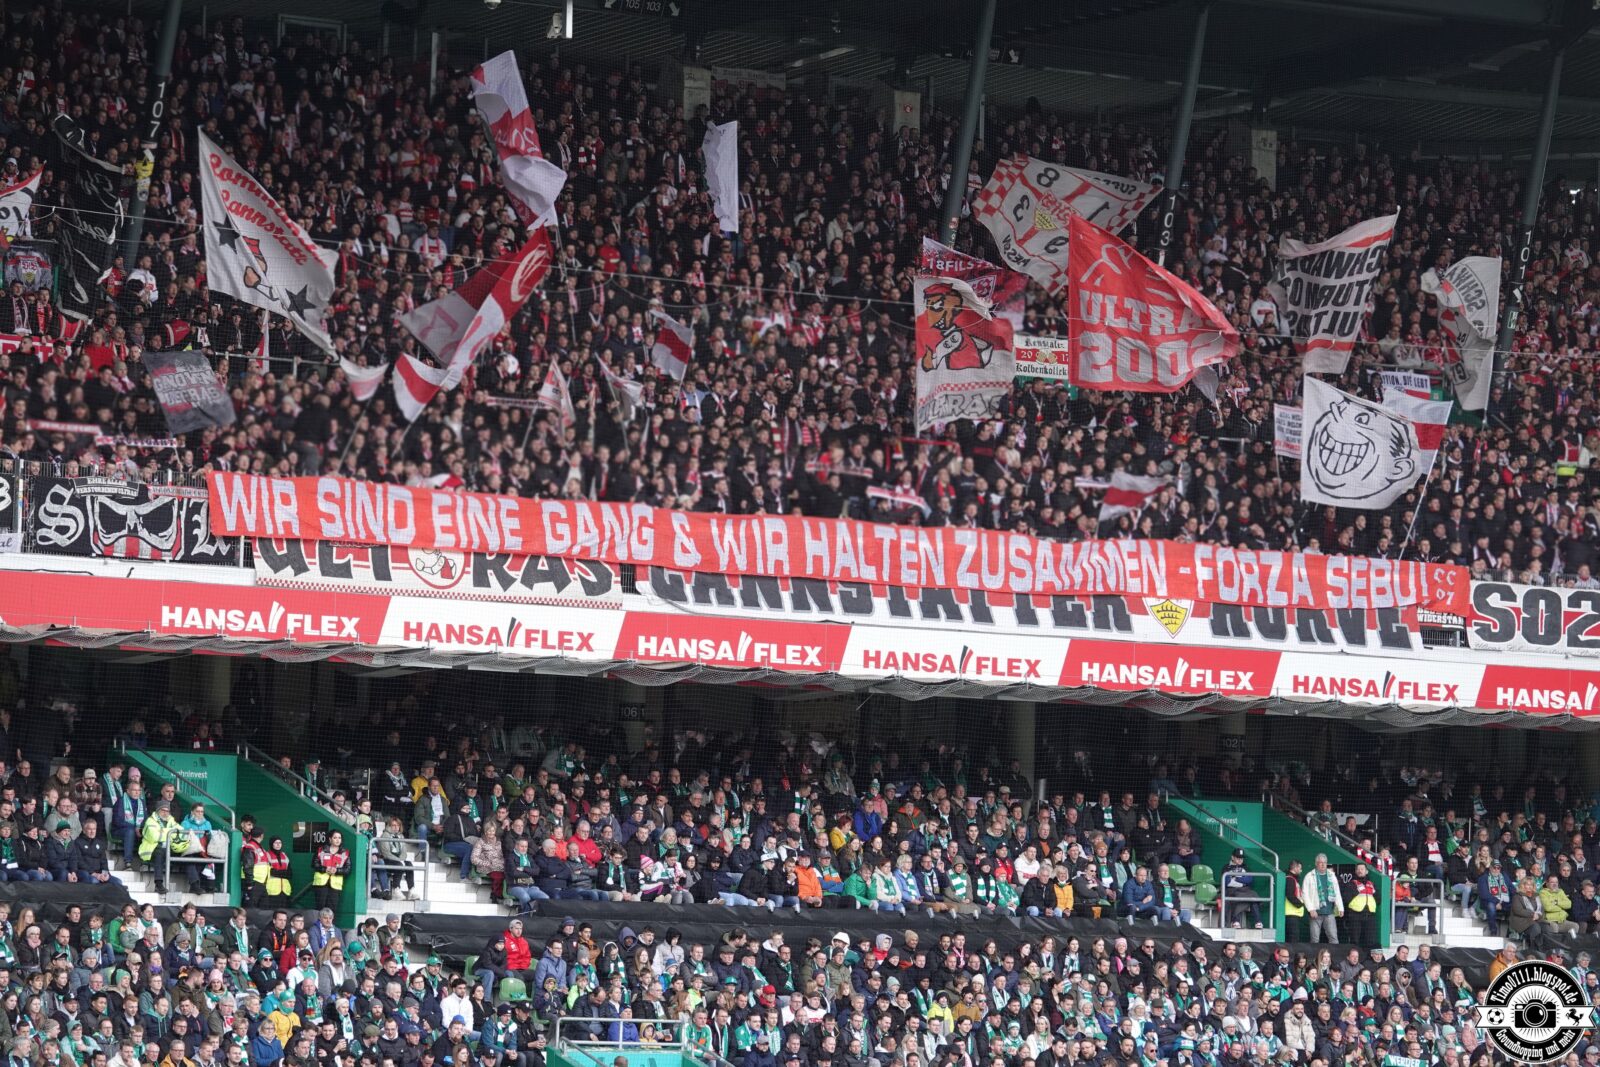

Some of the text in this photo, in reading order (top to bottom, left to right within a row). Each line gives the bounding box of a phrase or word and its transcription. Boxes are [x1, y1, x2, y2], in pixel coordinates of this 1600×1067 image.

[150, 81, 166, 139] 107
[1159, 195, 1177, 247] 103
[1518, 231, 1533, 279] 101
[1079, 289, 1212, 336] ULTRA
[1021, 350, 1032, 359] 20
[214, 473, 300, 537] WIR
[317, 477, 416, 545] SIND
[431, 492, 523, 552] EINE
[541, 500, 655, 562] GANG
[671, 512, 702, 568] &
[710, 518, 790, 576] WIR
[802, 519, 946, 587] HALTEN
[954, 529, 1168, 597] ZUSAMMEN
[1194, 544, 1315, 606] FORZA
[162, 606, 361, 638] HANSA FLEX
[403, 621, 595, 652] HANSA FLEX
[638, 635, 823, 667] HANSA FLEX
[863, 650, 1041, 679] HANSA FLEX
[1082, 662, 1254, 691] HANSA FLEX
[1293, 675, 1459, 702] HANSA FLEX
[1497, 687, 1584, 710] HANSA
[313, 831, 326, 843] 106
